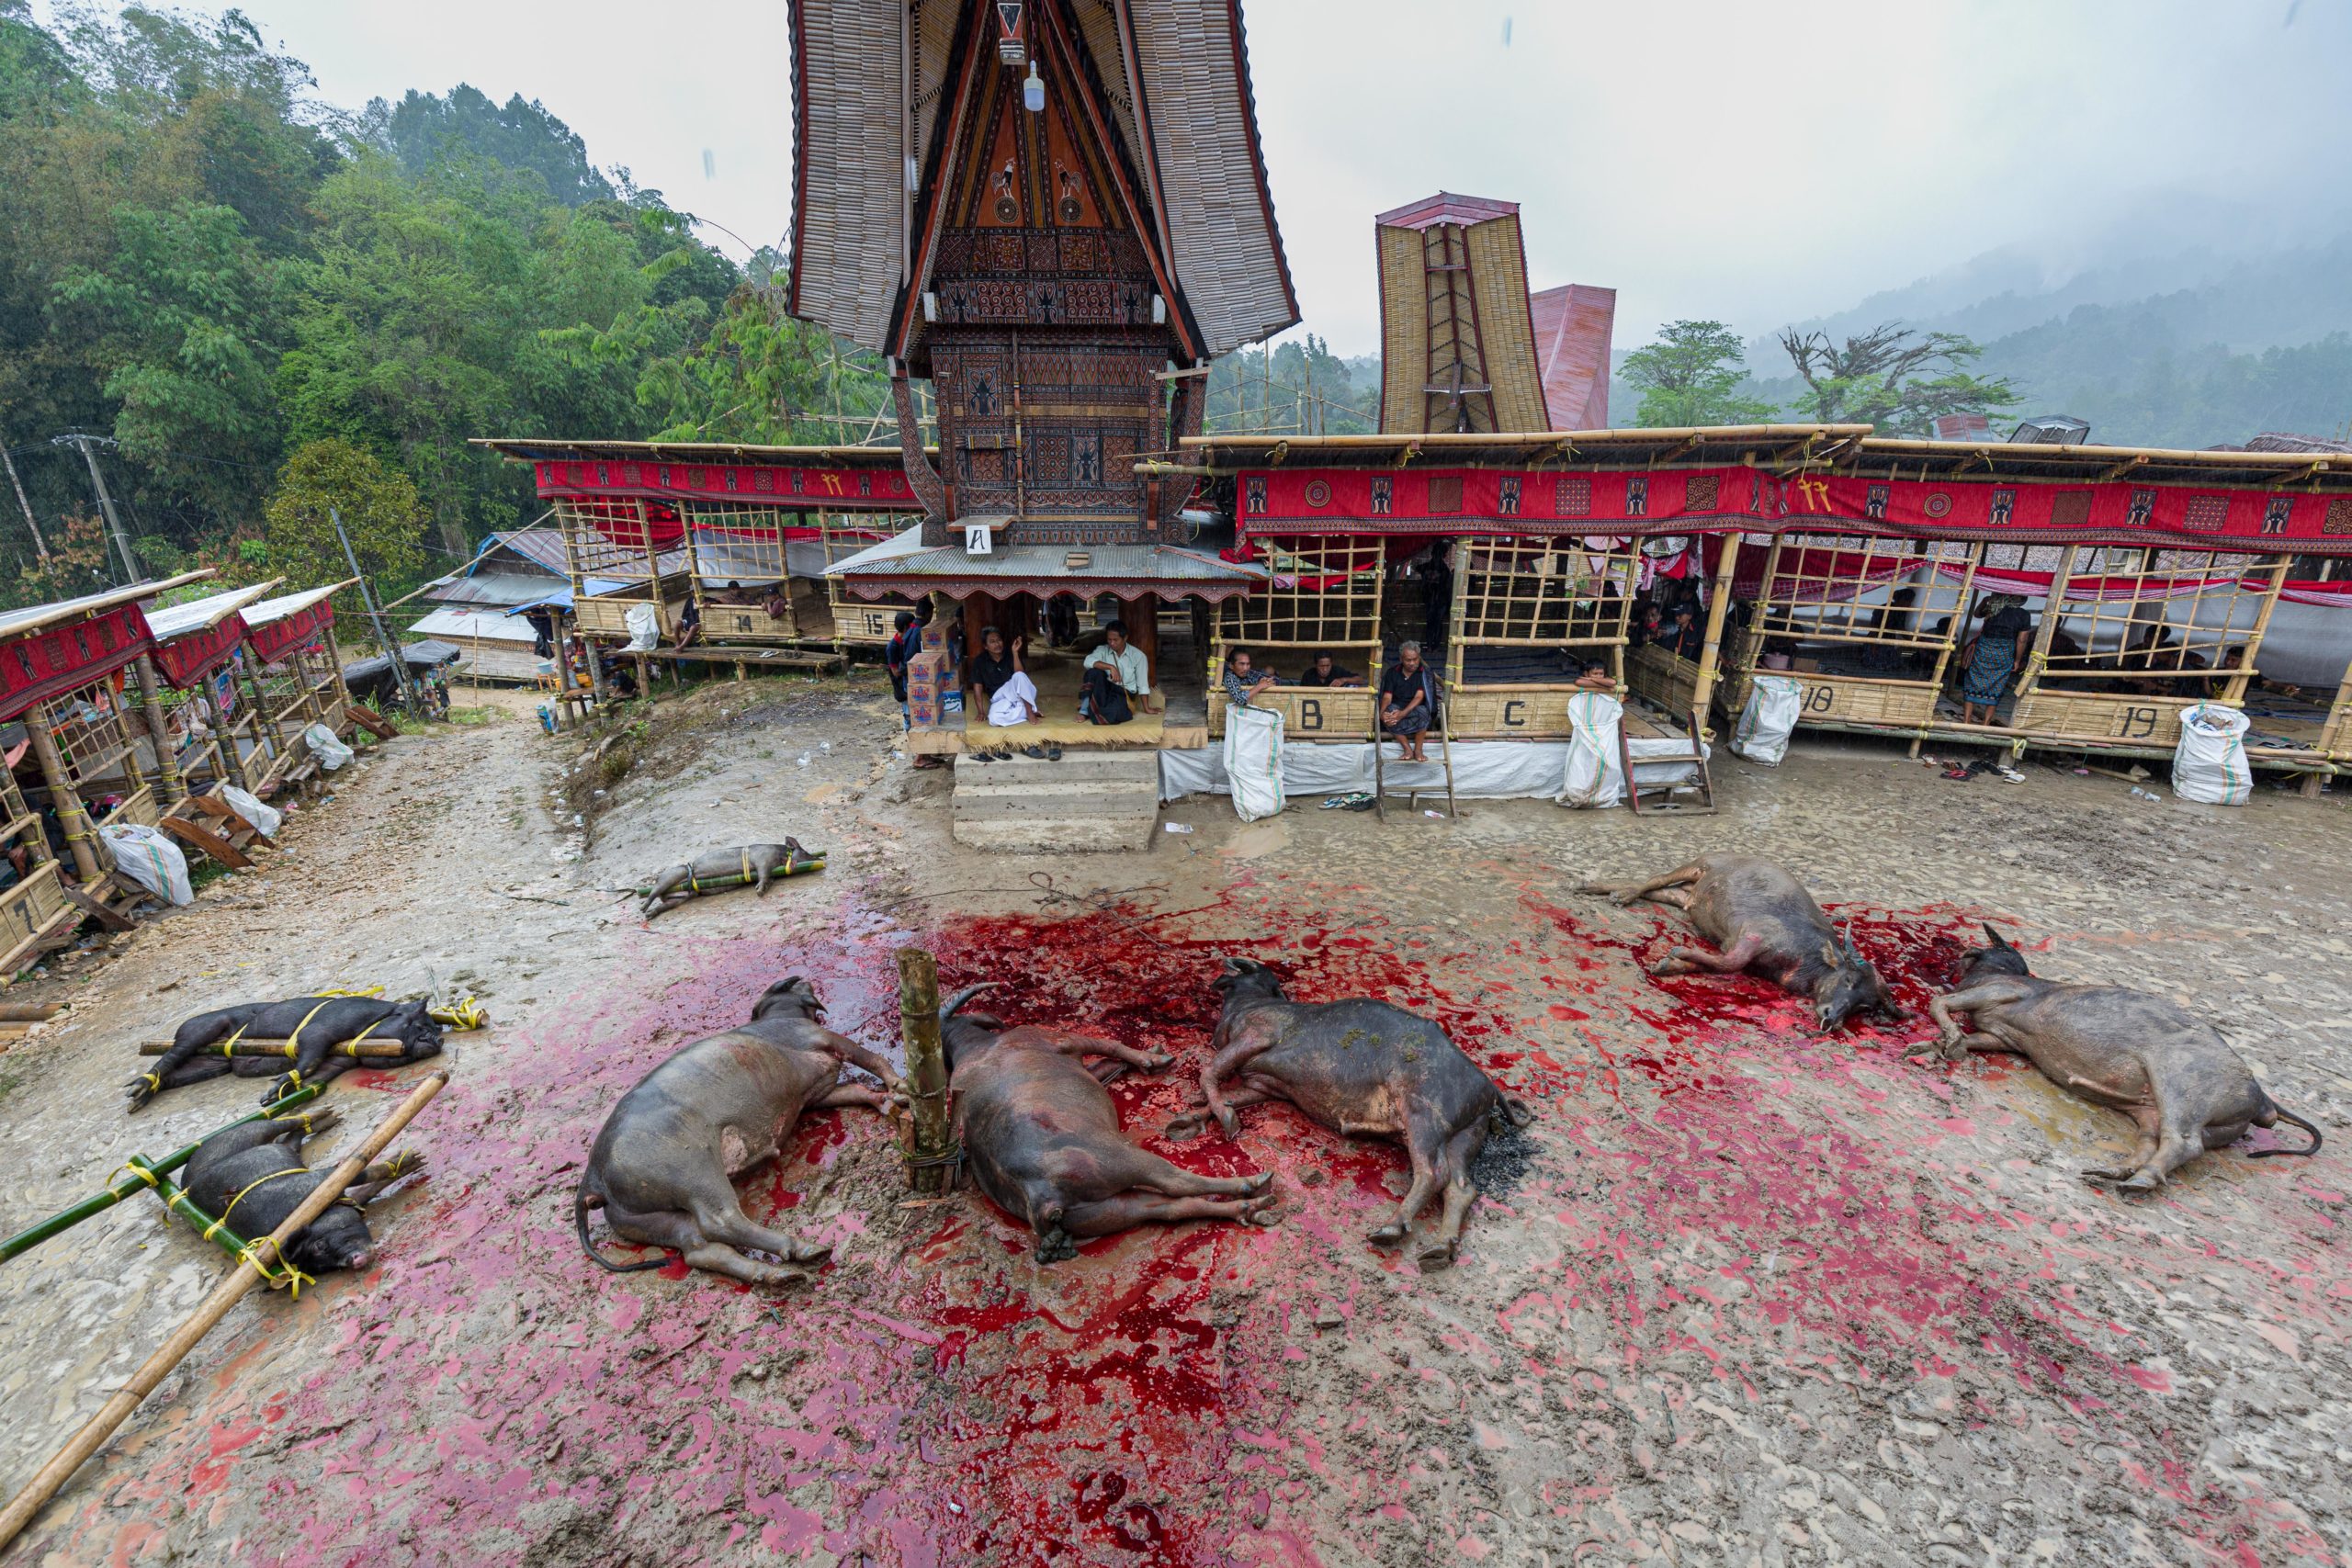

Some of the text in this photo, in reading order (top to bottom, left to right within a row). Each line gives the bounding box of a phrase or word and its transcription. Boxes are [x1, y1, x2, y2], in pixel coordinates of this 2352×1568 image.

[968, 529, 985, 549] A
[736, 615, 752, 633] 14
[865, 614, 884, 635] 15
[1802, 686, 1833, 712] 18
[1302, 700, 1323, 729] B
[1504, 701, 1525, 726] C
[2120, 706, 2157, 738] 19
[14, 899, 38, 933] 7
